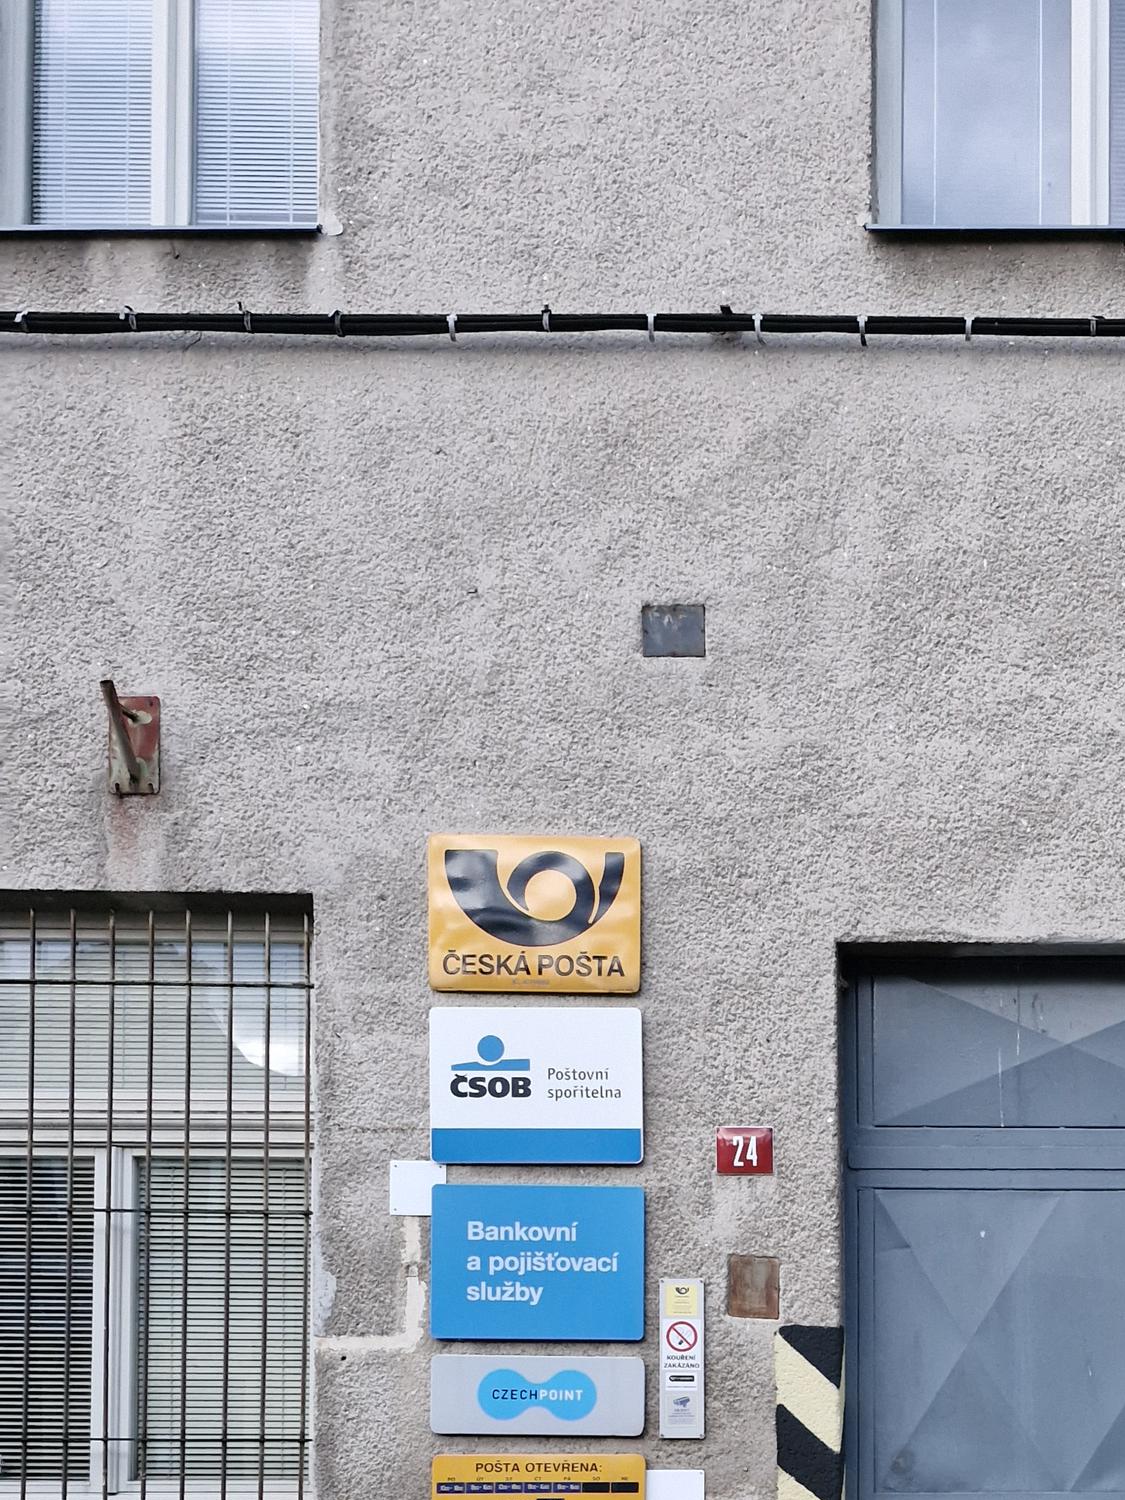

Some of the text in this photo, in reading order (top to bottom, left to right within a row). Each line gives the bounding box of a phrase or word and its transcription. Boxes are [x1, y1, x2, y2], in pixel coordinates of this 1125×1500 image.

[442, 949, 626, 977] ČESKÁ POŠTA
[449, 1073, 532, 1098] ČSOB
[547, 1067, 609, 1081] Poštovní
[547, 1085, 622, 1101] spořitelna
[732, 1135, 758, 1167] 24
[467, 1221, 579, 1242] Bankovní
[466, 1251, 620, 1276] a pojišťovací
[466, 1281, 544, 1306] služby
[475, 1460, 602, 1473] POŠTA OTEVŘENA:
